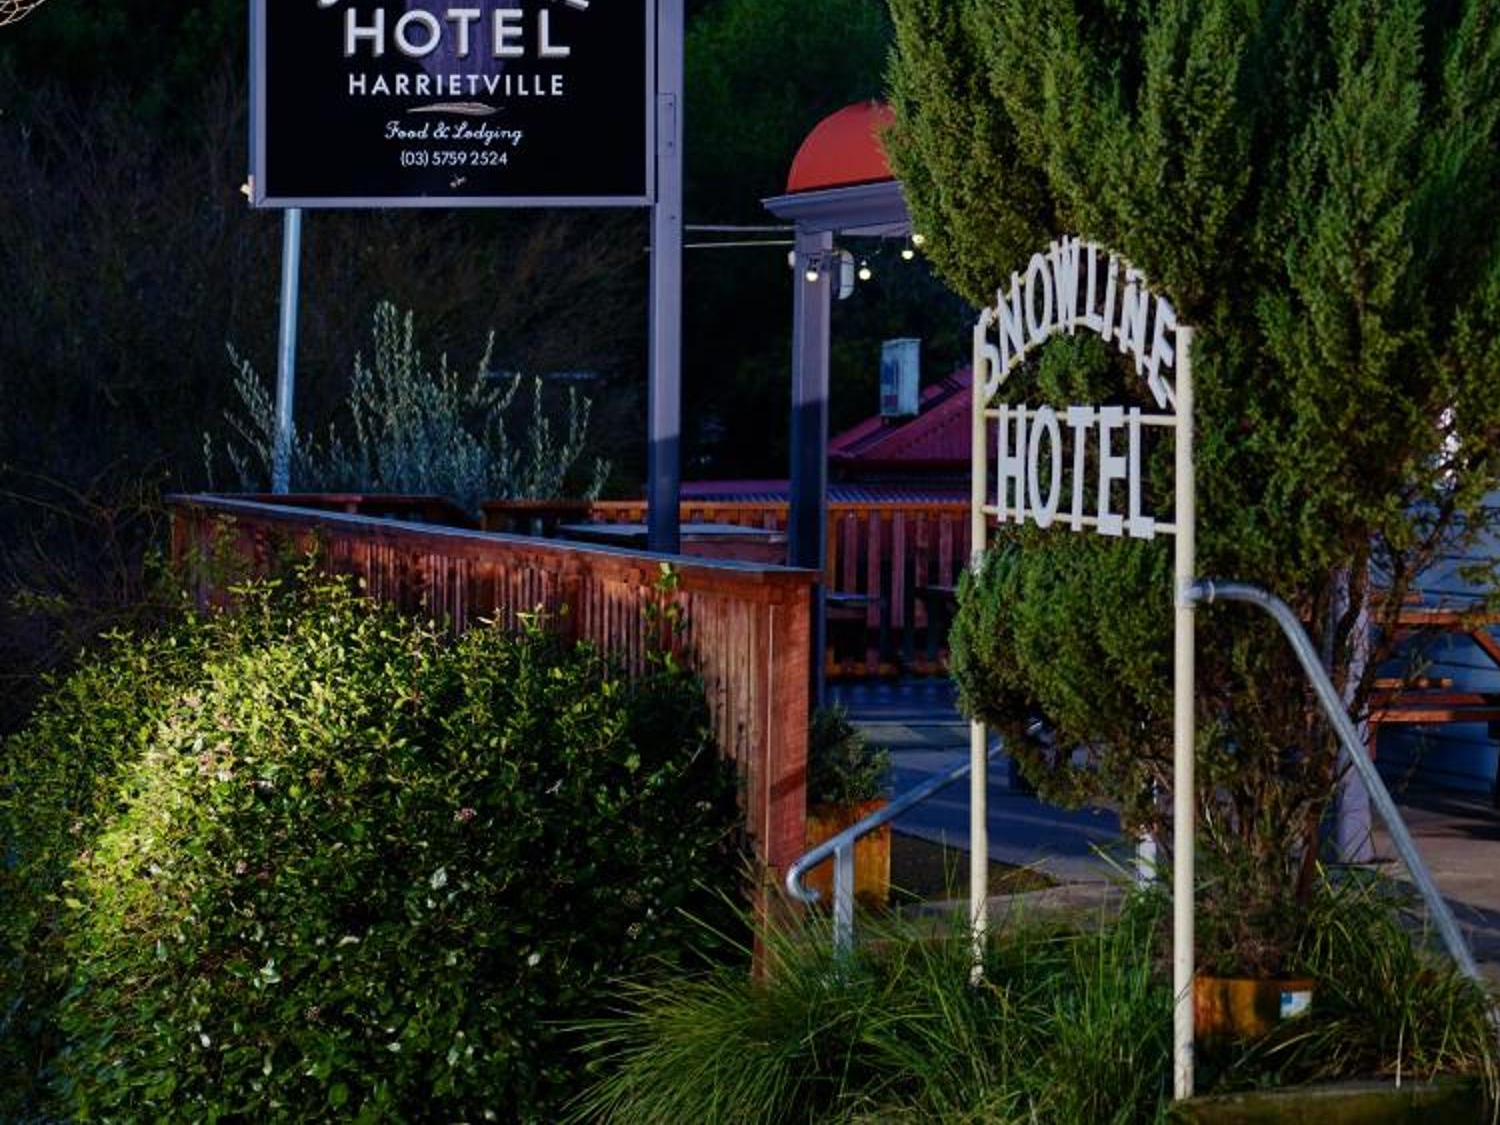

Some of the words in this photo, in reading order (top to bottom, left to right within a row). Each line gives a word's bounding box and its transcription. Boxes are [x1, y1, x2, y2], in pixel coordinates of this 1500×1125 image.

[344, 7, 571, 58] HOTEL
[348, 74, 564, 96] HARRIETVILLE
[385, 120, 430, 139] Food
[433, 120, 450, 139] &
[451, 120, 523, 146] Lodging
[401, 149, 429, 167] (03)
[431, 151, 467, 166] 5759
[469, 151, 508, 166] 2524
[974, 234, 1176, 408] SNOWLINE
[997, 403, 1155, 539] HOTEL
